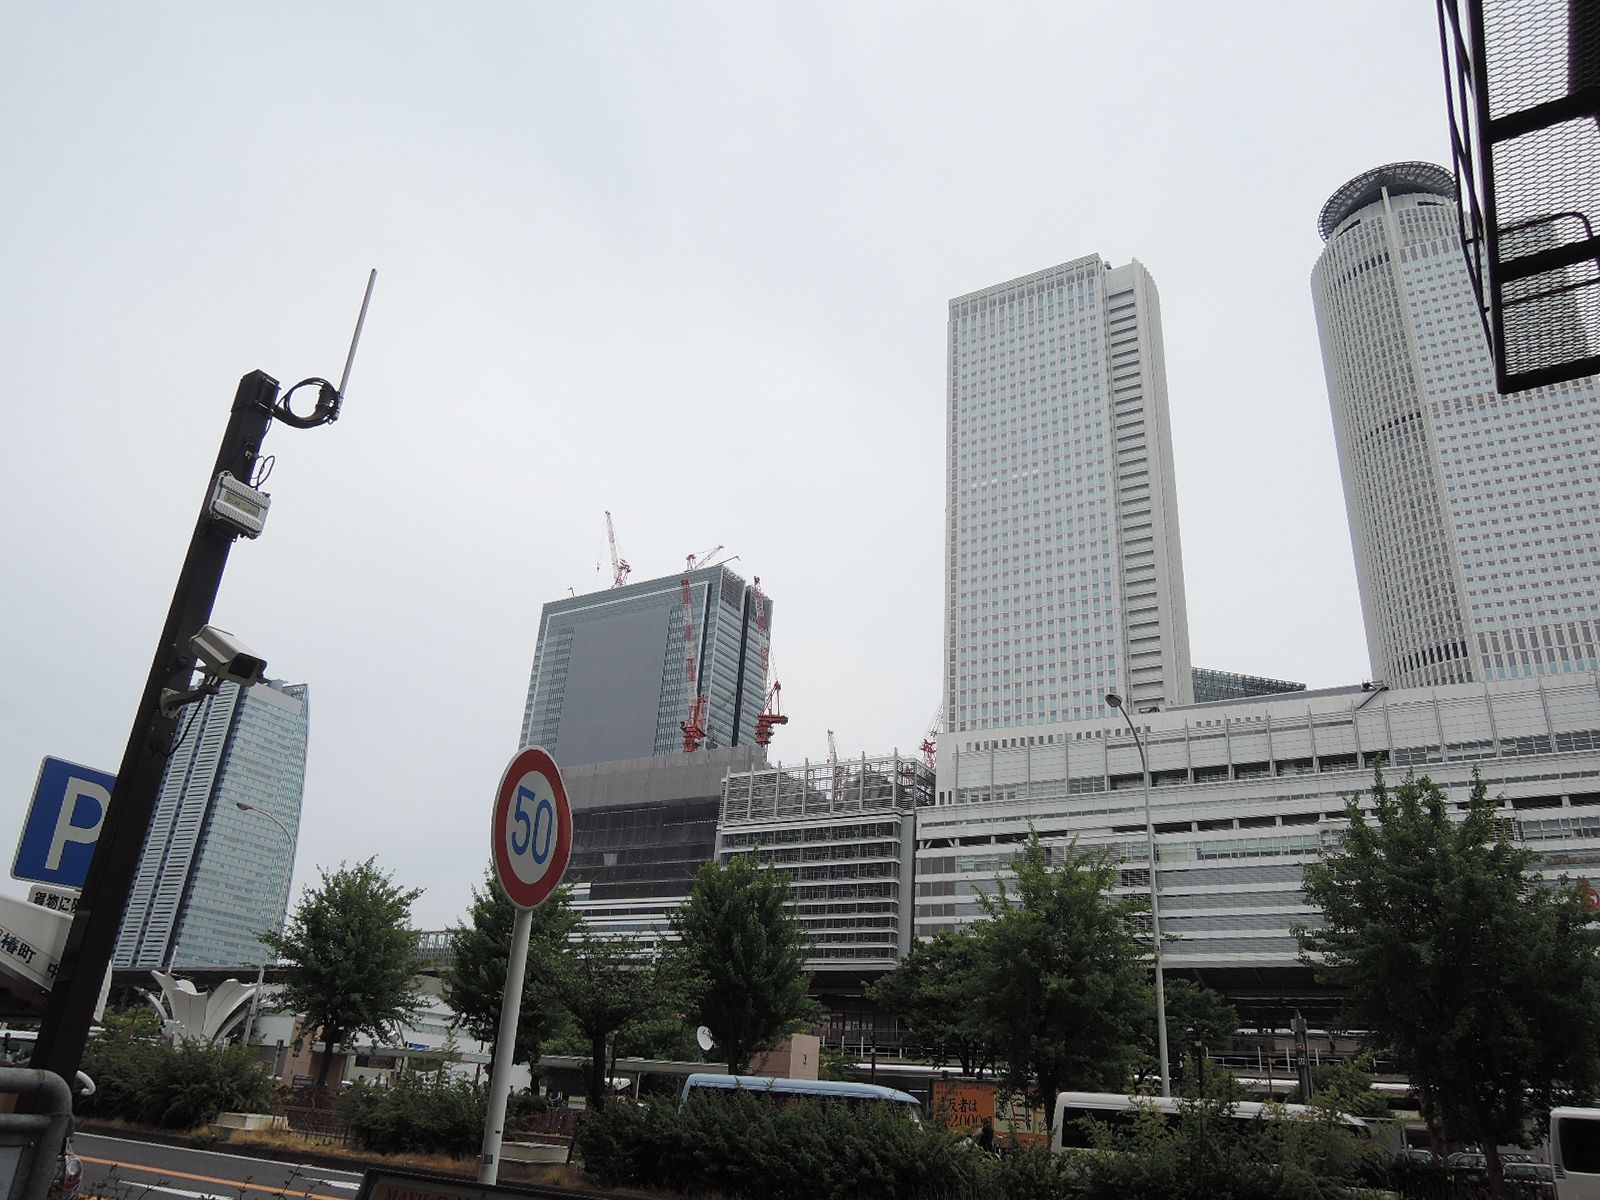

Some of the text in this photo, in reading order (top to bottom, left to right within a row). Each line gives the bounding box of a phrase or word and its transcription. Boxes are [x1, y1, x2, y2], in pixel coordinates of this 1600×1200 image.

[45, 776, 110, 870] P
[511, 785, 553, 864] 50
[1, 932, 36, 965] 椿町
[938, 1096, 977, 1113] 反者は
